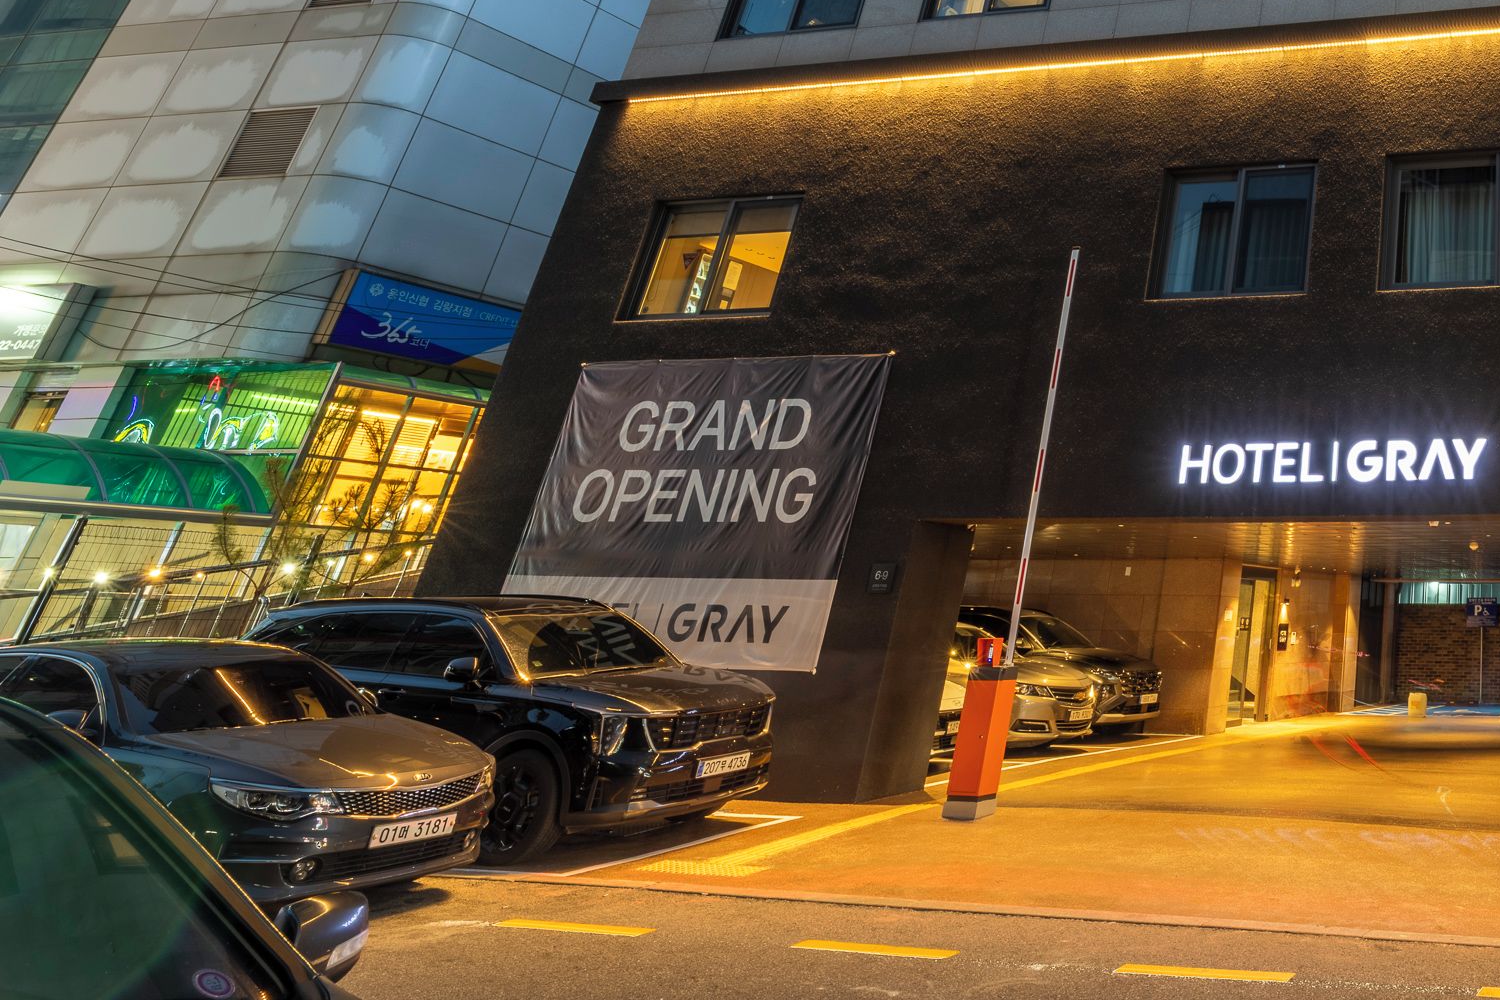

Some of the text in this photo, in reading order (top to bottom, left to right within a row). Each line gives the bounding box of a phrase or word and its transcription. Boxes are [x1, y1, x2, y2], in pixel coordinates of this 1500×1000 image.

[387, 288, 429, 307] 용인신협
[619, 399, 812, 452] GRAND
[1178, 438, 1487, 484] HOTEL GRAY
[572, 467, 817, 524] OPENING
[667, 603, 790, 644] GRAY
[379, 817, 449, 843] 01머 3181
